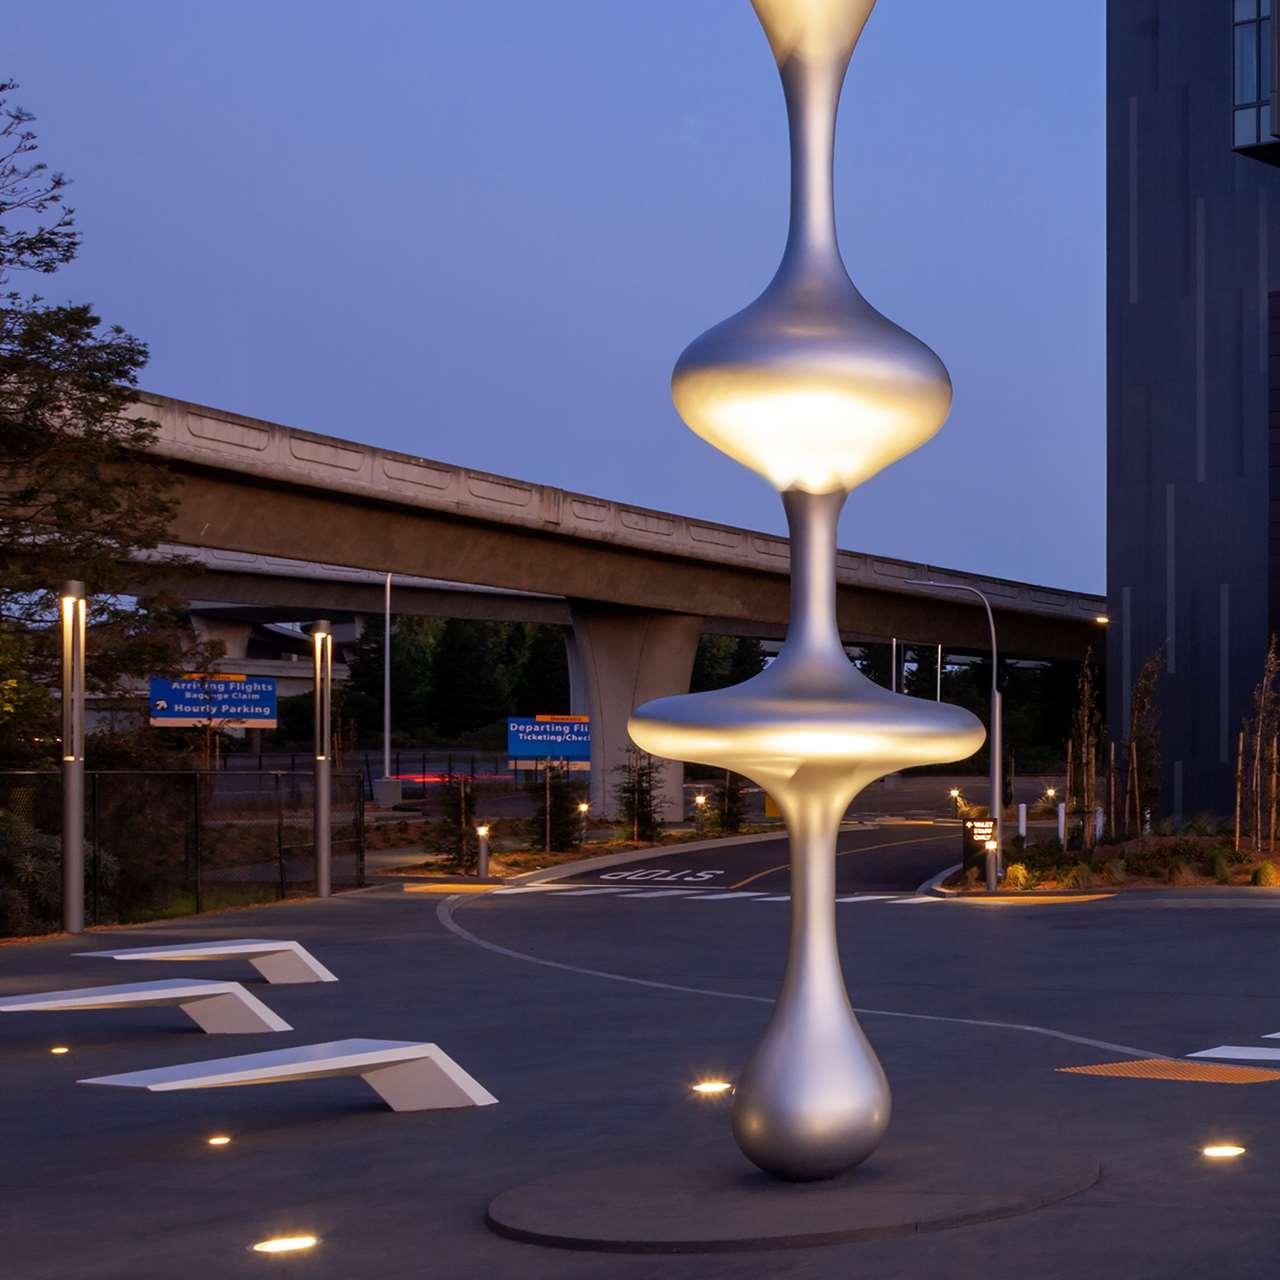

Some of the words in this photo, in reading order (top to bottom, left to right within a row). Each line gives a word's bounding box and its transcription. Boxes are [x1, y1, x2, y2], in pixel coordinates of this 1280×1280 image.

[229, 681, 273, 693] Flights
[231, 692, 260, 700] Claim
[174, 703, 218, 715] Hourly
[221, 703, 271, 715] Parking
[510, 723, 570, 733] Departing
[600, 869, 725, 881] STOP
